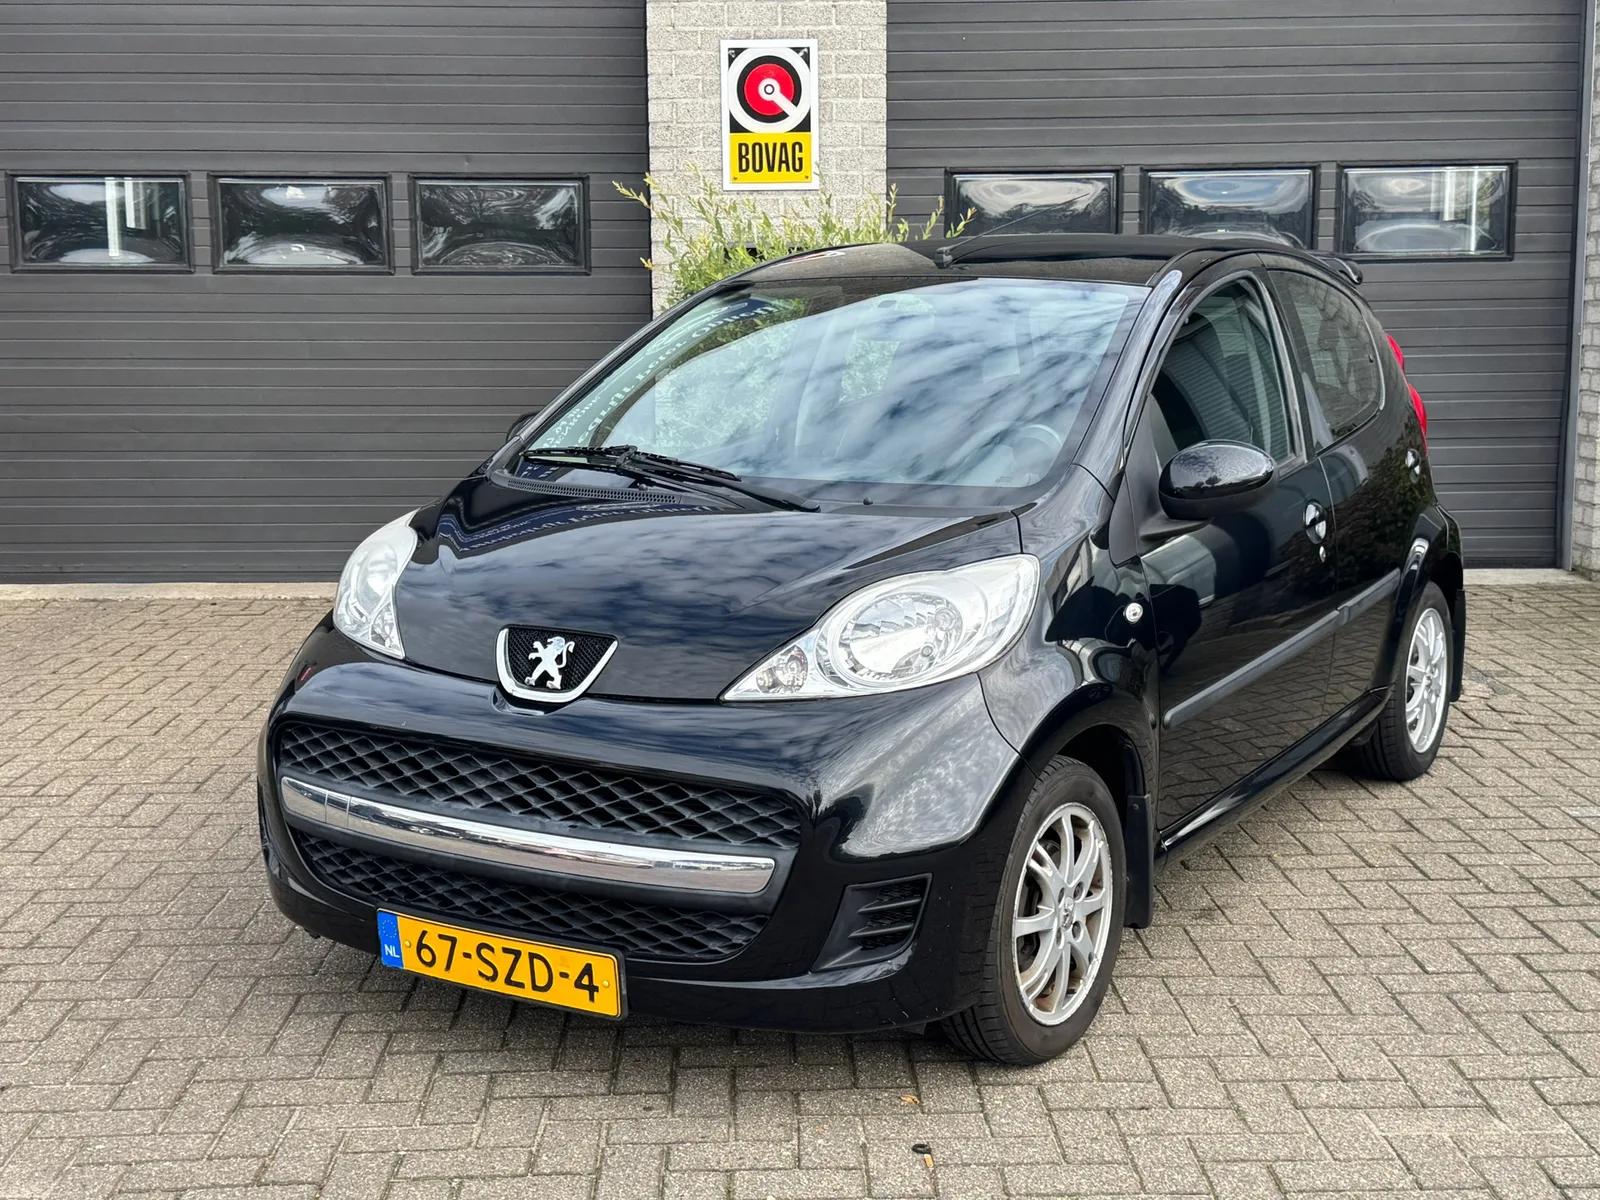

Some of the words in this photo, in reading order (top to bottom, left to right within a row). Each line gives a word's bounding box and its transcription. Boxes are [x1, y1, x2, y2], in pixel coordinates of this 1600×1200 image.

[738, 142, 803, 173] BOVAG
[384, 944, 400, 959] NL
[415, 929, 600, 1003] 67-SZD-4
